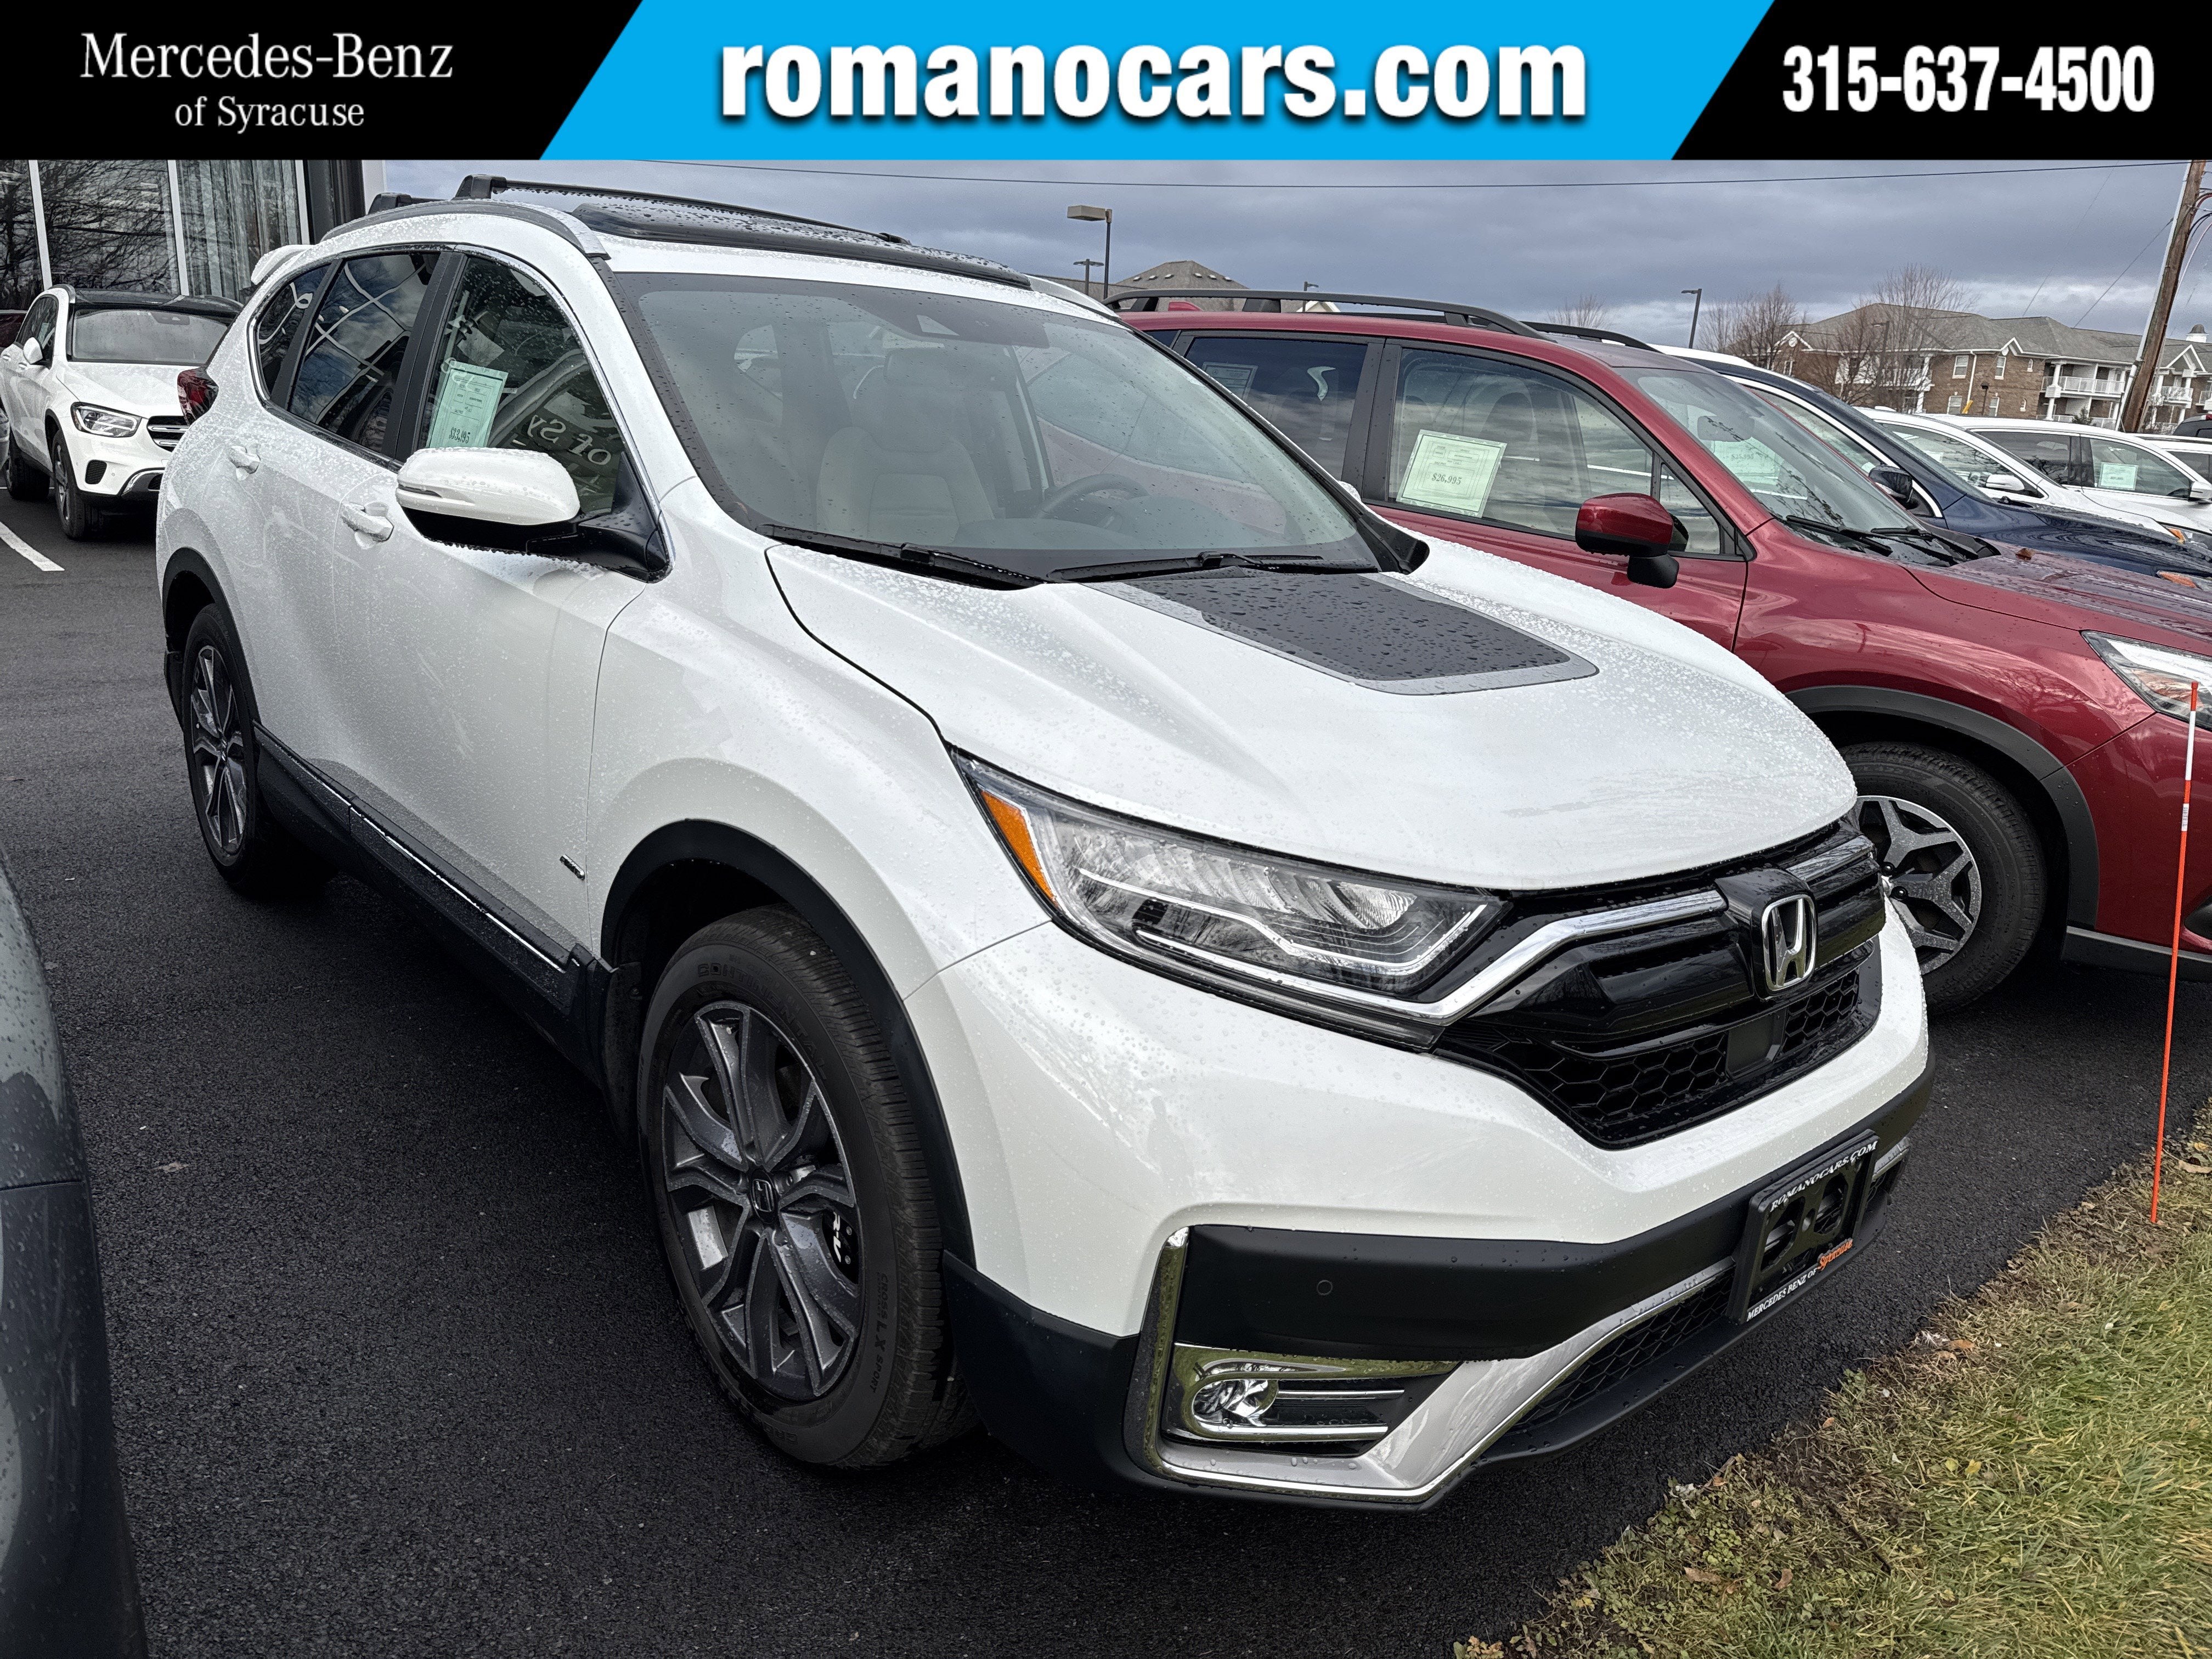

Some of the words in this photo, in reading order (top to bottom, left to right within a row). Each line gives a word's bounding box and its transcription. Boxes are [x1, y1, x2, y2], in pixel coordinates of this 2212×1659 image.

[1431, 472, 1462, 485] $26,995
[697, 962, 827, 1080] CONTINENTAL
[1769, 1140, 1878, 1212] ROMANOCARS.COM
[833, 1211, 842, 1263] R-V
[1746, 1288, 1787, 1322] MERCEDES
[1787, 1274, 1807, 1295] BENZ
[1807, 1267, 1818, 1279] OF
[870, 1355, 884, 1393] SPORT
